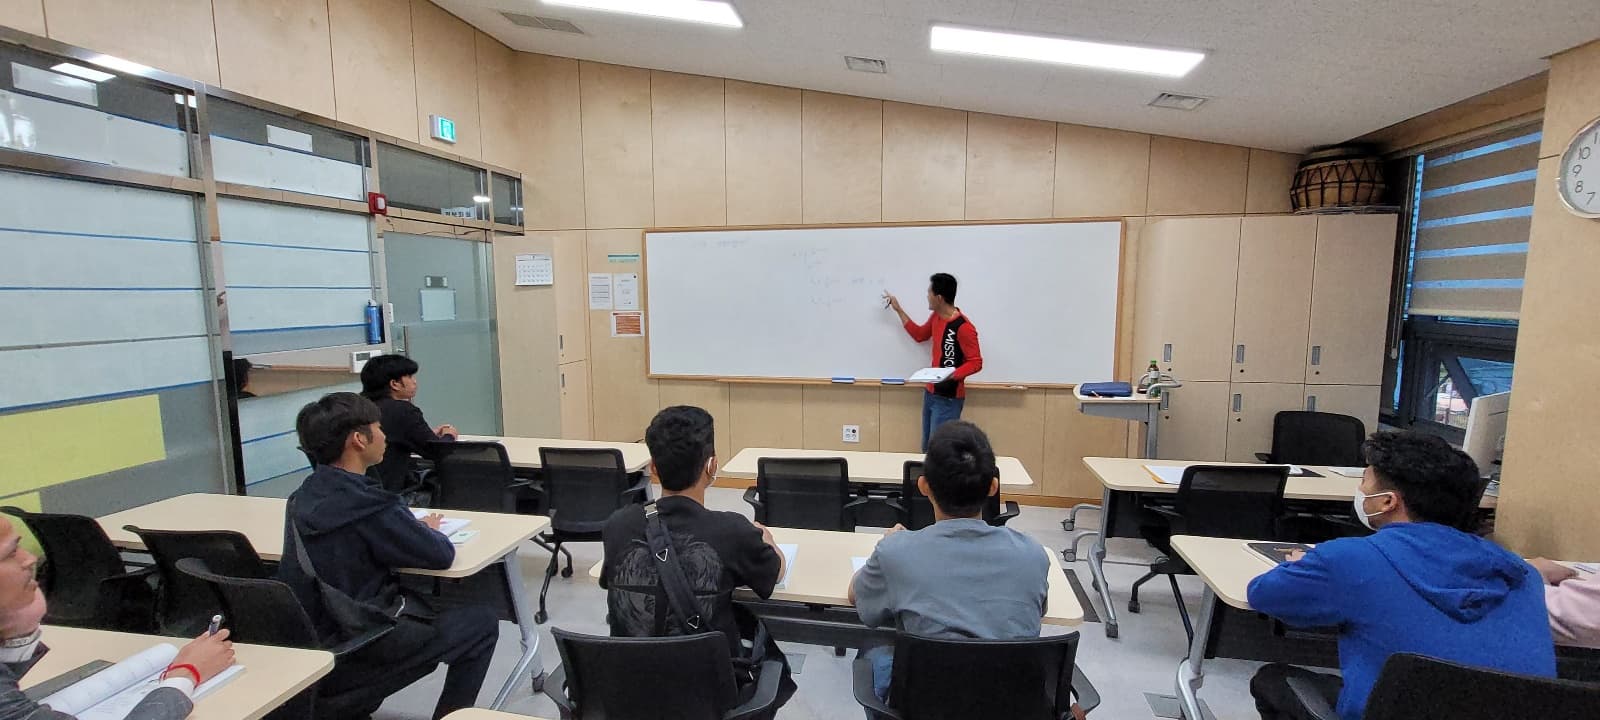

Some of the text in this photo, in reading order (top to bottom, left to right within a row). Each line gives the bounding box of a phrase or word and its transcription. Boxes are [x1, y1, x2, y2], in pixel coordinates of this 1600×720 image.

[1578, 146, 1591, 160] 10
[1573, 164, 1582, 177] 9
[1574, 181, 1584, 193] 8
[1586, 191, 1596, 206] 7
[944, 328, 956, 367] MISSIO
